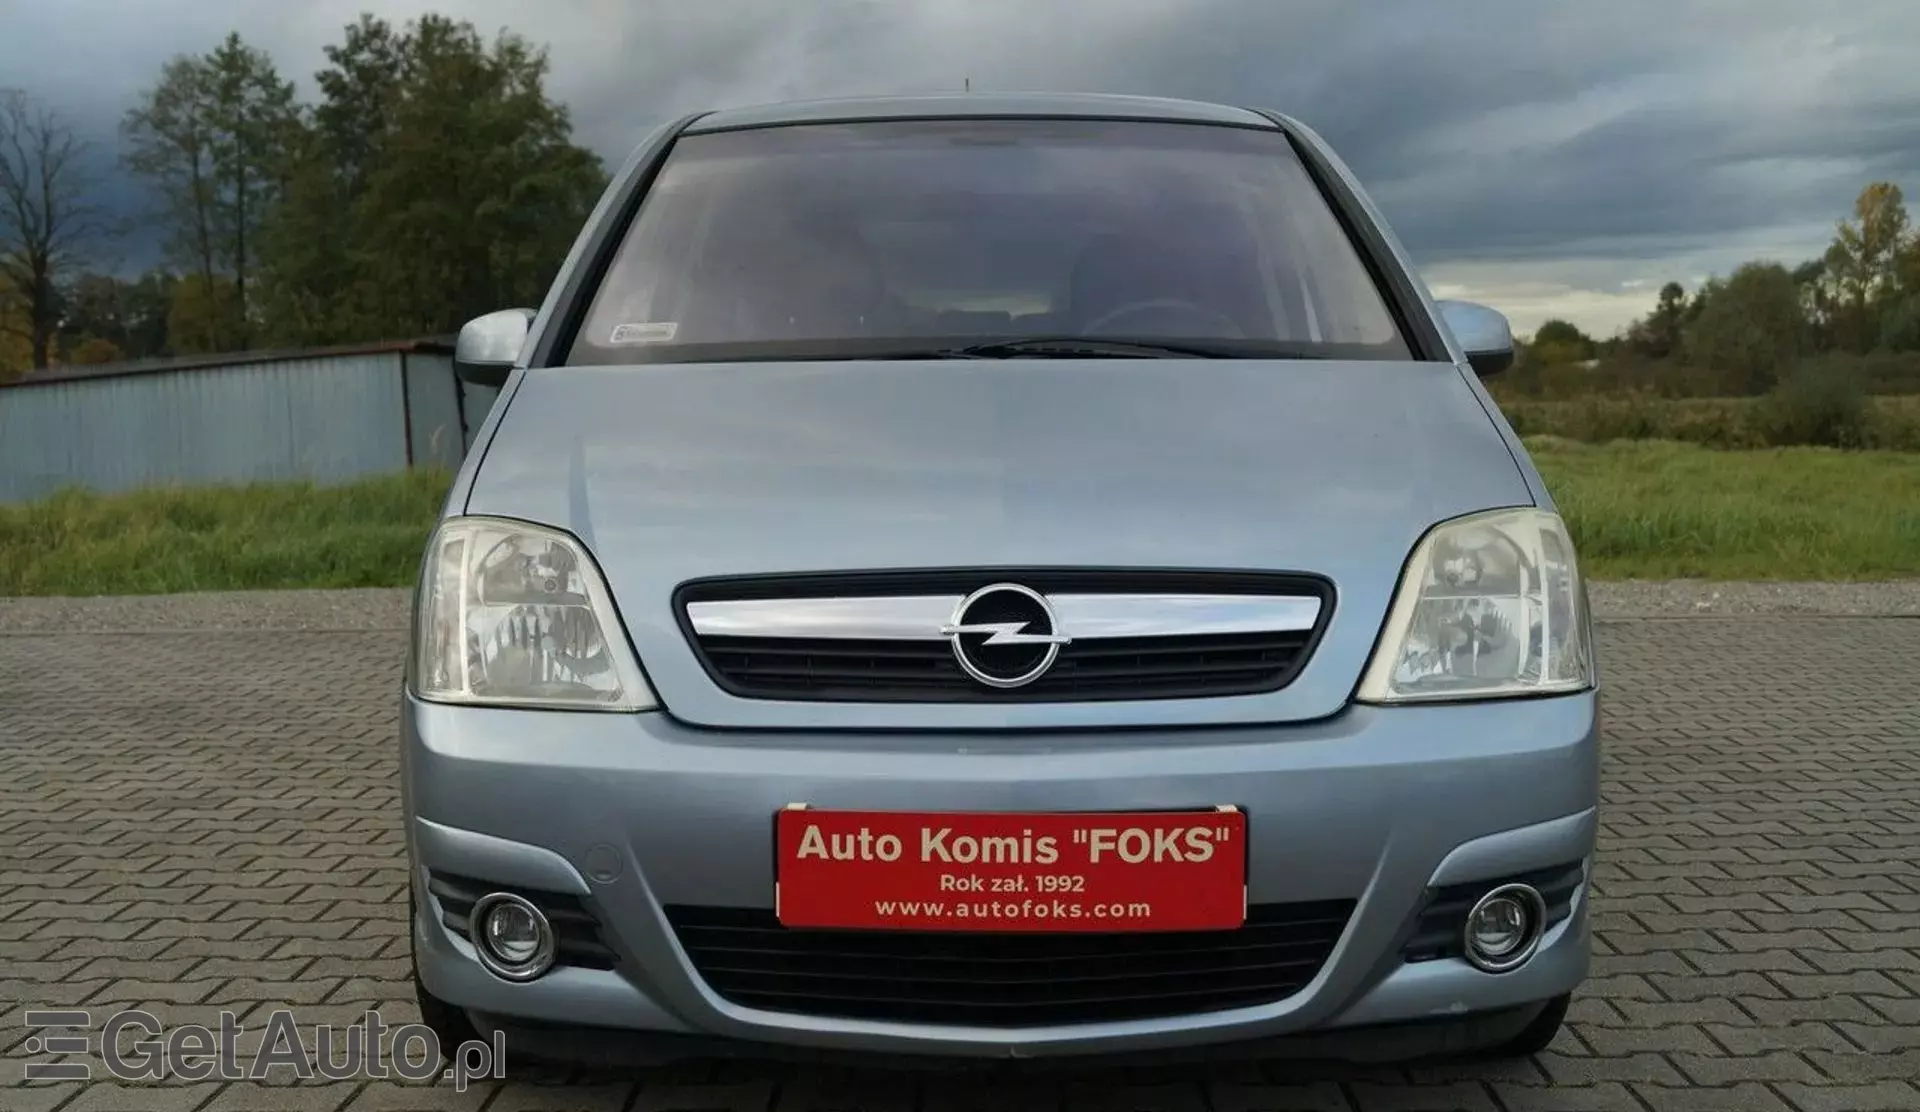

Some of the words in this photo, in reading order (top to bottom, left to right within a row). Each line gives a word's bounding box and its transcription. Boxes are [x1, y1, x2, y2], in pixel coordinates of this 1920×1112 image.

[797, 825, 902, 862] Auto
[921, 827, 1059, 864] Komis
[1073, 826, 1229, 864] "FOKS"
[940, 874, 984, 892] Rok
[991, 874, 1029, 893] zał.
[1035, 875, 1085, 893] 1992
[875, 900, 1151, 919] www.autofoks.com
